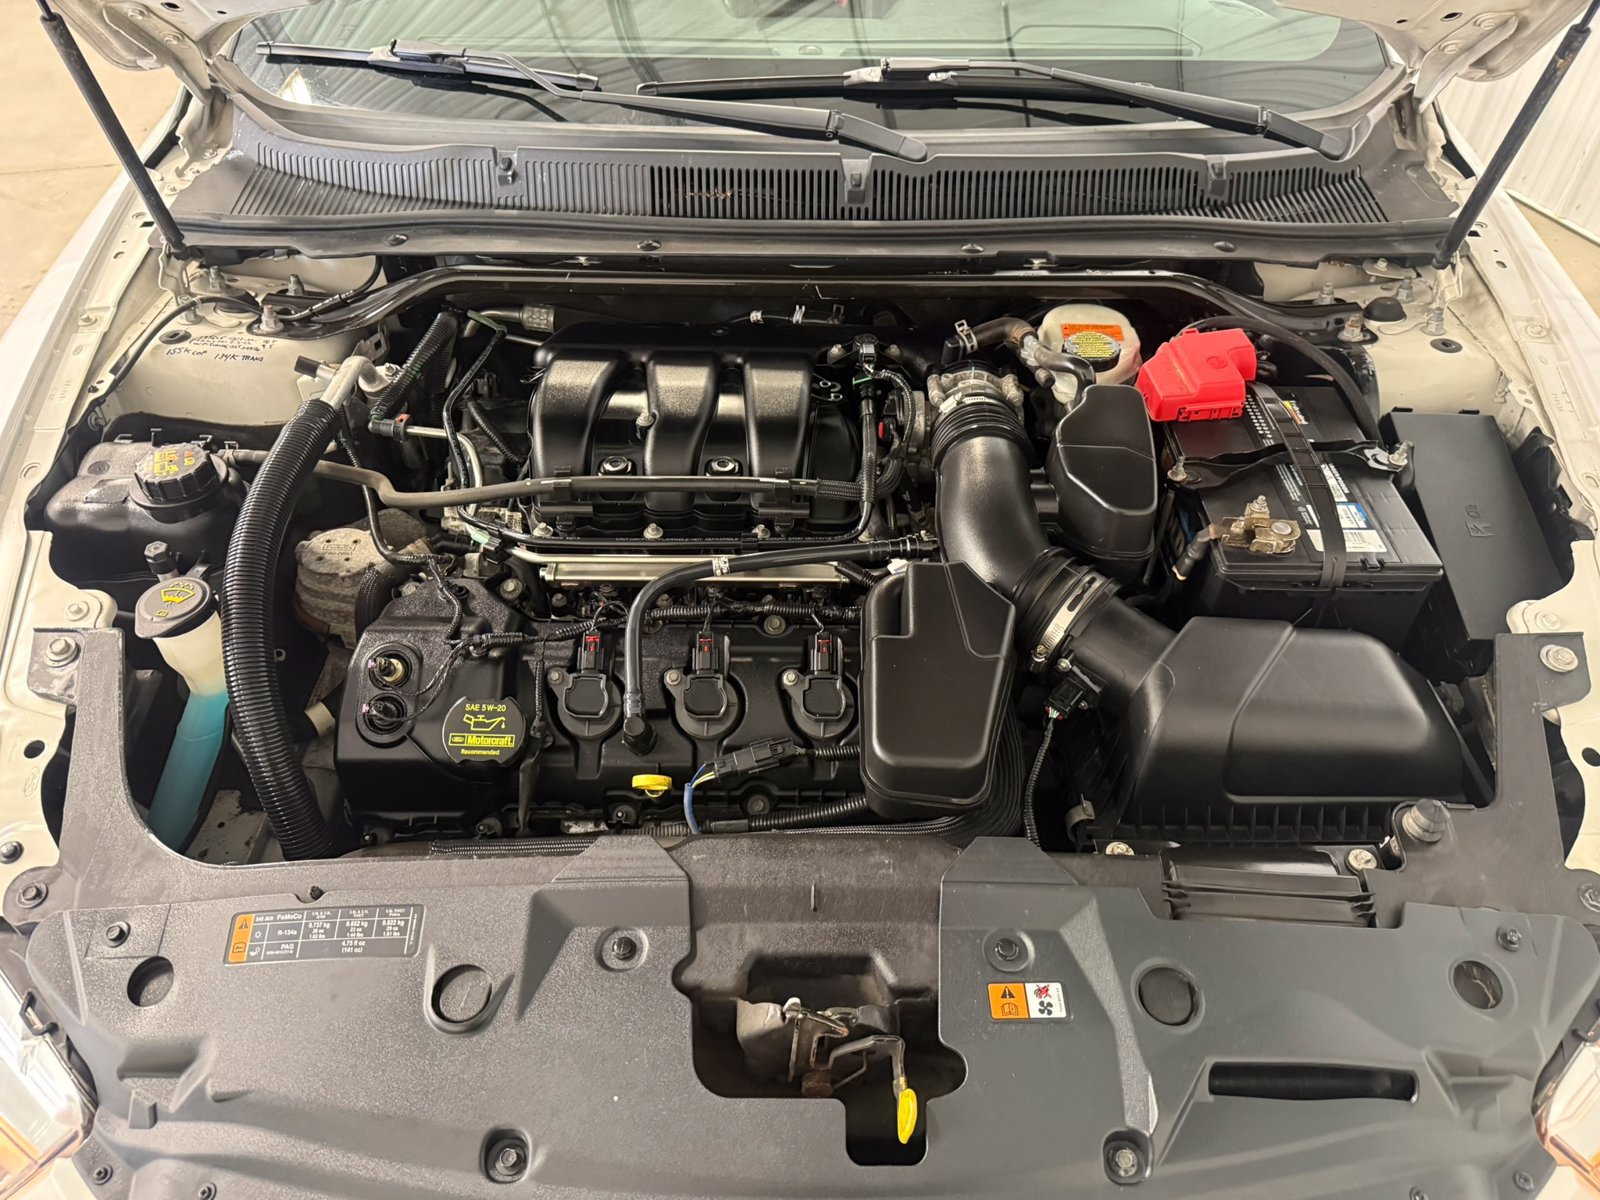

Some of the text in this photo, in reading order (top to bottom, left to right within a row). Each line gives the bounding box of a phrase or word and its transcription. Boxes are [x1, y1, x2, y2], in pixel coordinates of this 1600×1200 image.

[465, 703, 481, 711] SAE
[467, 735, 512, 747] Motorcraft
[461, 748, 500, 756] Recommended
[276, 913, 303, 921] FoMoCo
